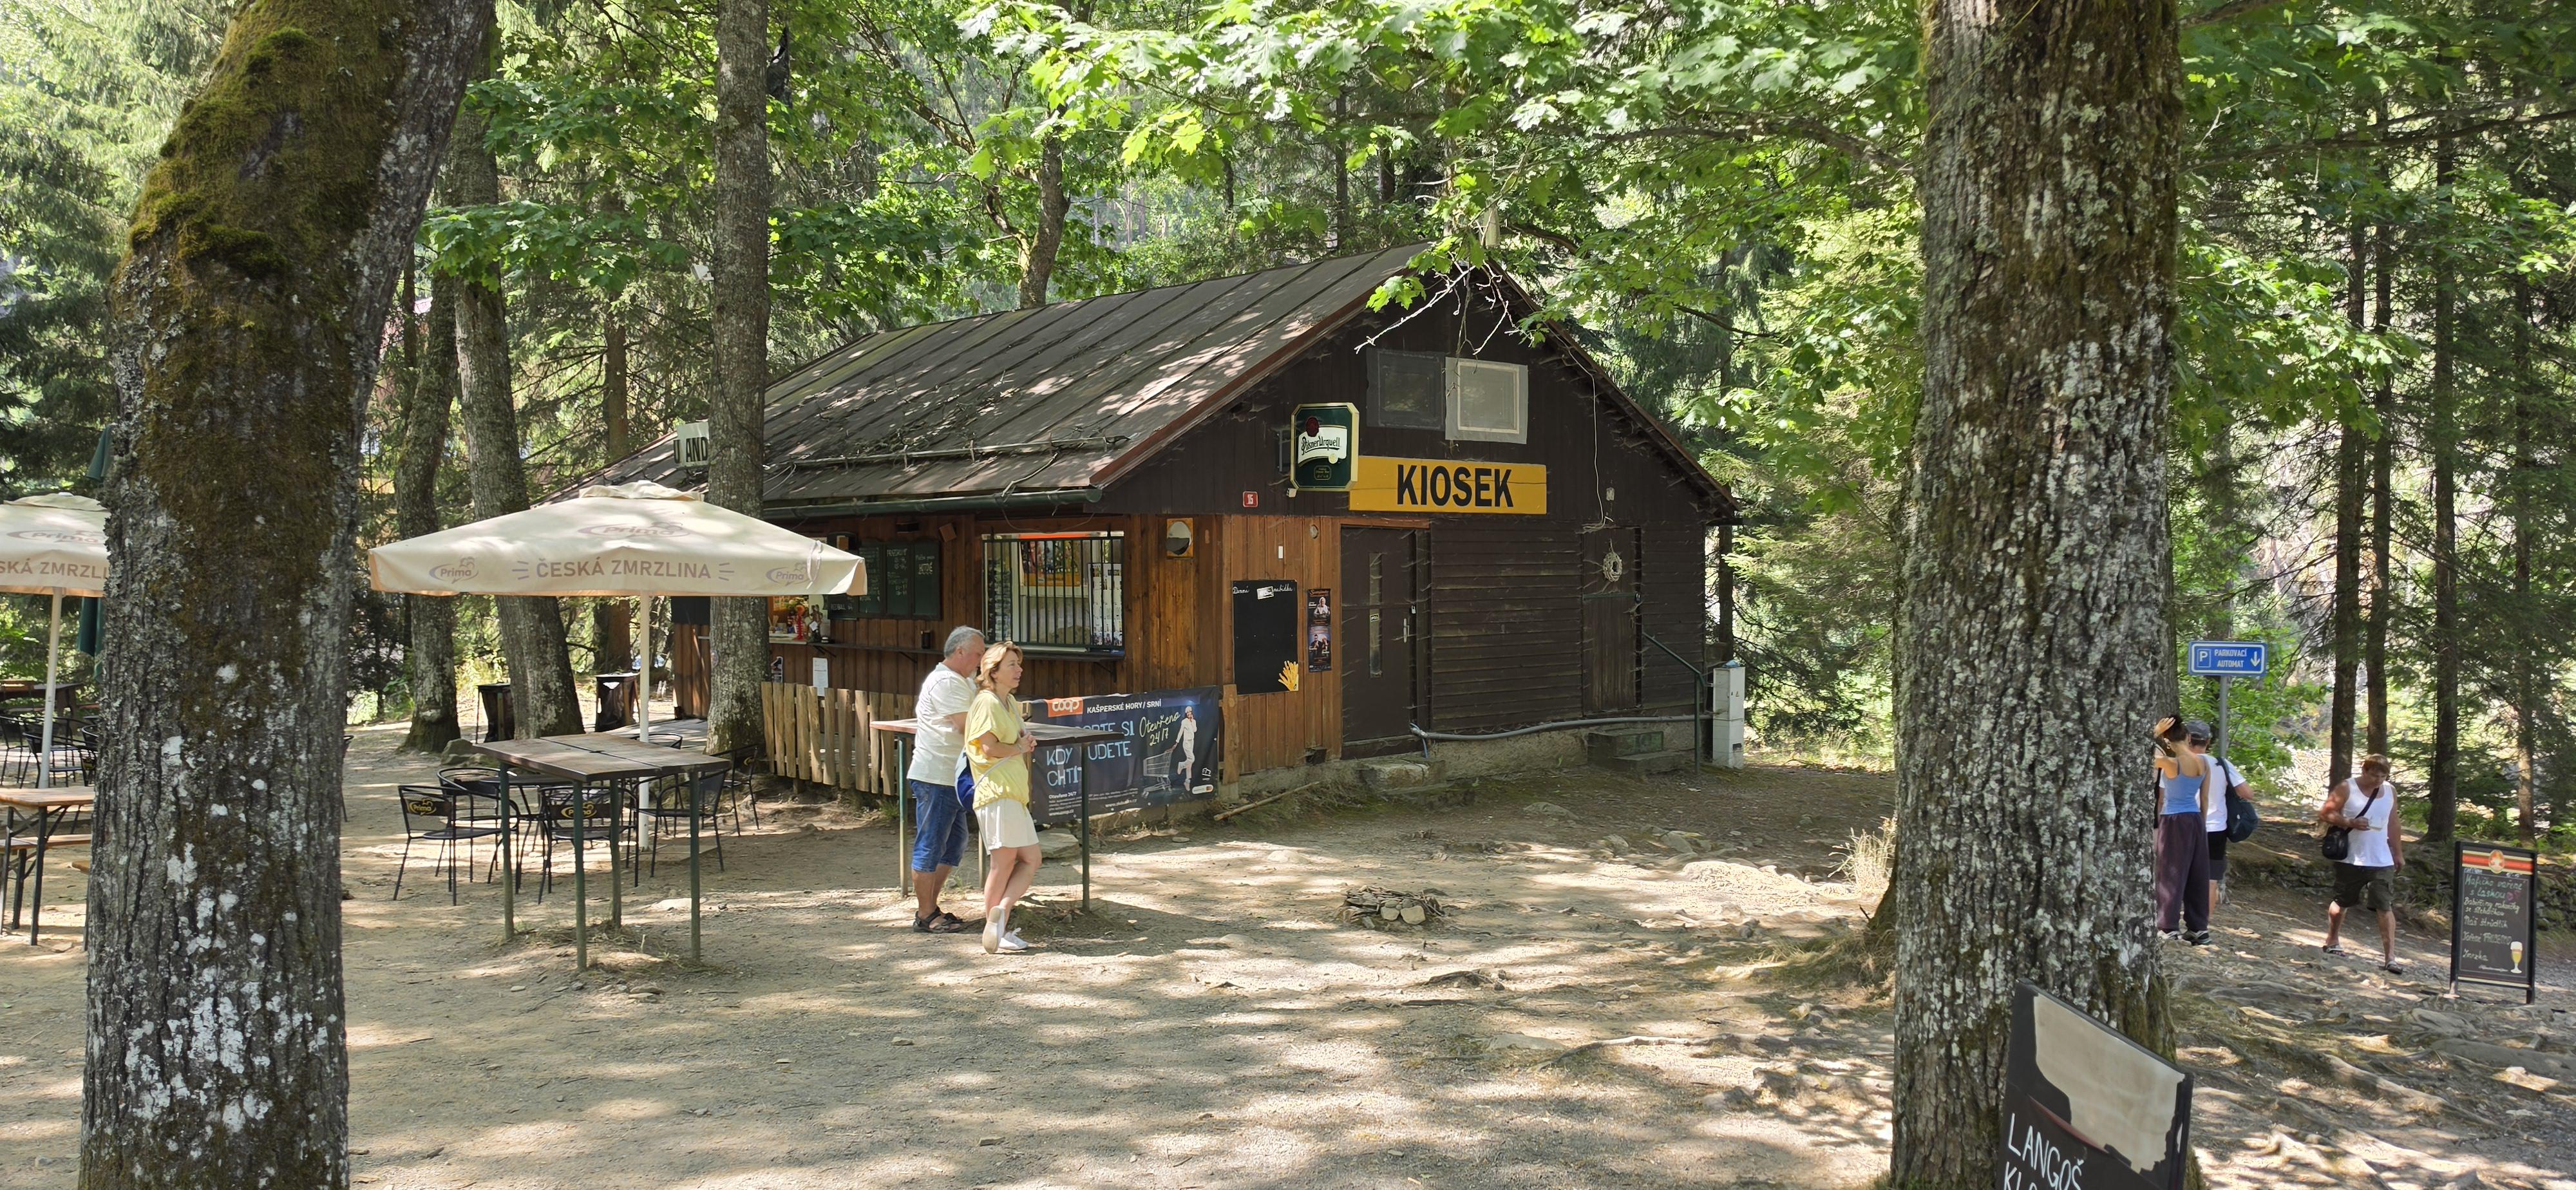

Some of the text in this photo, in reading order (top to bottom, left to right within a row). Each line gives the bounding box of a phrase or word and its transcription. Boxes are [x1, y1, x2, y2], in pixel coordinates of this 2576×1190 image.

[1302, 435, 1340, 455] Pilsner Urquell
[1397, 464, 1513, 507] KIOSEK
[32, 532, 98, 543] Prima
[604, 525, 675, 536] Prima
[0, 558, 110, 579] SKÁ ZMRZLI
[440, 568, 471, 577] Prima
[536, 557, 711, 578] ČESKÁ ZMRZLINA
[776, 571, 804, 580] Prima
[2199, 648, 2248, 662] P PARKOVACÍ
[1087, 704, 1124, 714] KAŠPERSKÉ
[1146, 699, 1162, 708] SRNÍ
[1121, 721, 1135, 737] SI
[1139, 712, 1181, 738] Otevřeno
[1150, 728, 1169, 746] 24/7
[1046, 741, 1132, 766] KDY UDETE
[2008, 1113, 2085, 1190] LANGOŠ
